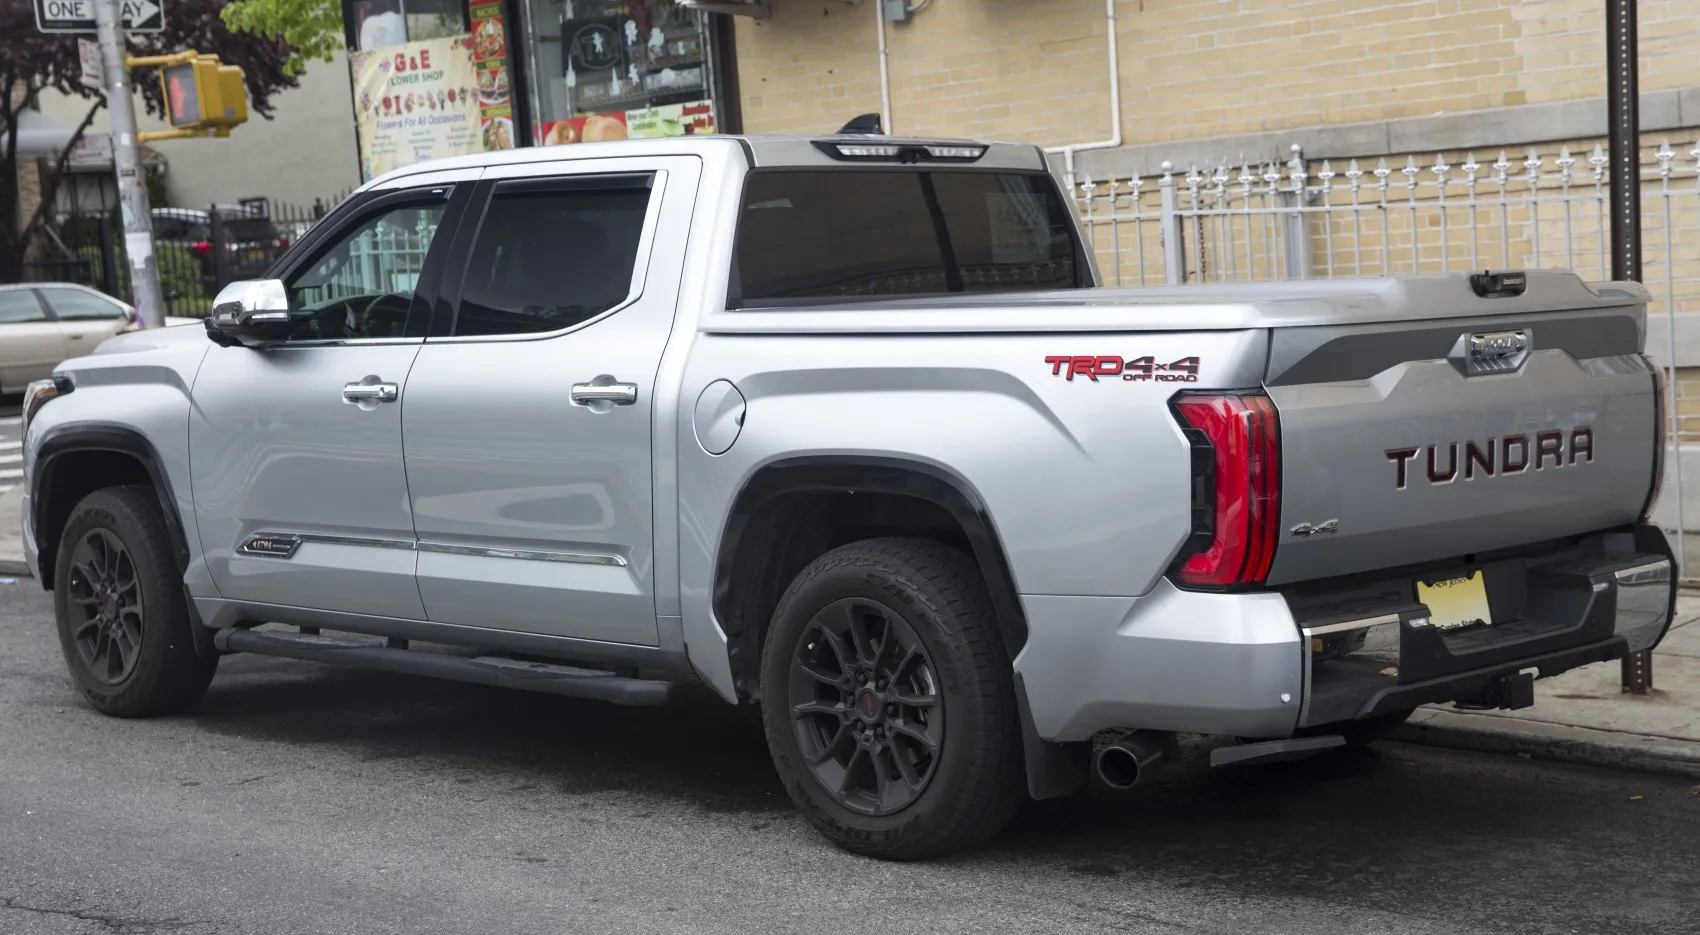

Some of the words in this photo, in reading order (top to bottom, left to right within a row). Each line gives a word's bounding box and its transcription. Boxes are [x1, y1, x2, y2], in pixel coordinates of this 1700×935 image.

[48, 1, 85, 17] ONE
[422, 70, 444, 82] SHOP
[1045, 355, 1124, 382] TRD
[1123, 374, 1152, 382] OFF
[1154, 374, 1198, 382] ROAD
[1384, 425, 1595, 491] TUNDRA
